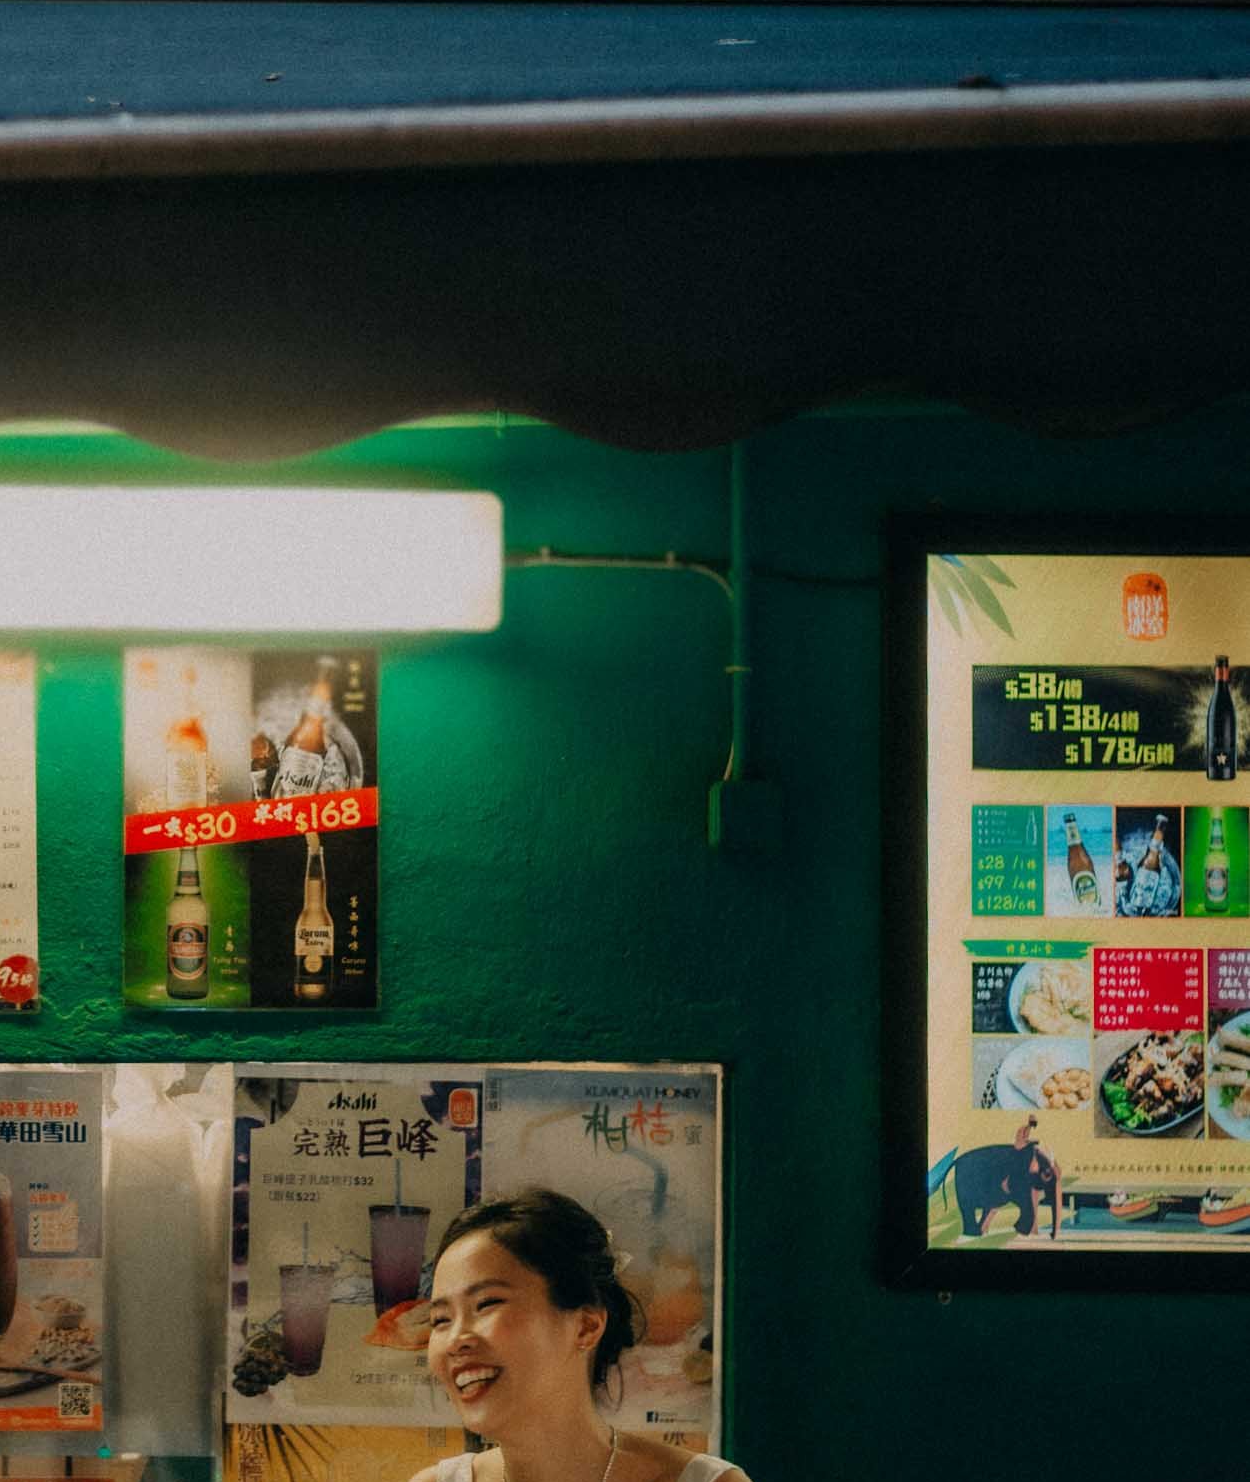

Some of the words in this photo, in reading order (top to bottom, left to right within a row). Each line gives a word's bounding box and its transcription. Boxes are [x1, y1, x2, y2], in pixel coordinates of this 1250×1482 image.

[327, 1090, 378, 1112] Asahi
[655, 1085, 701, 1100] HONEY
[293, 1117, 439, 1161] 完熟巨峰
